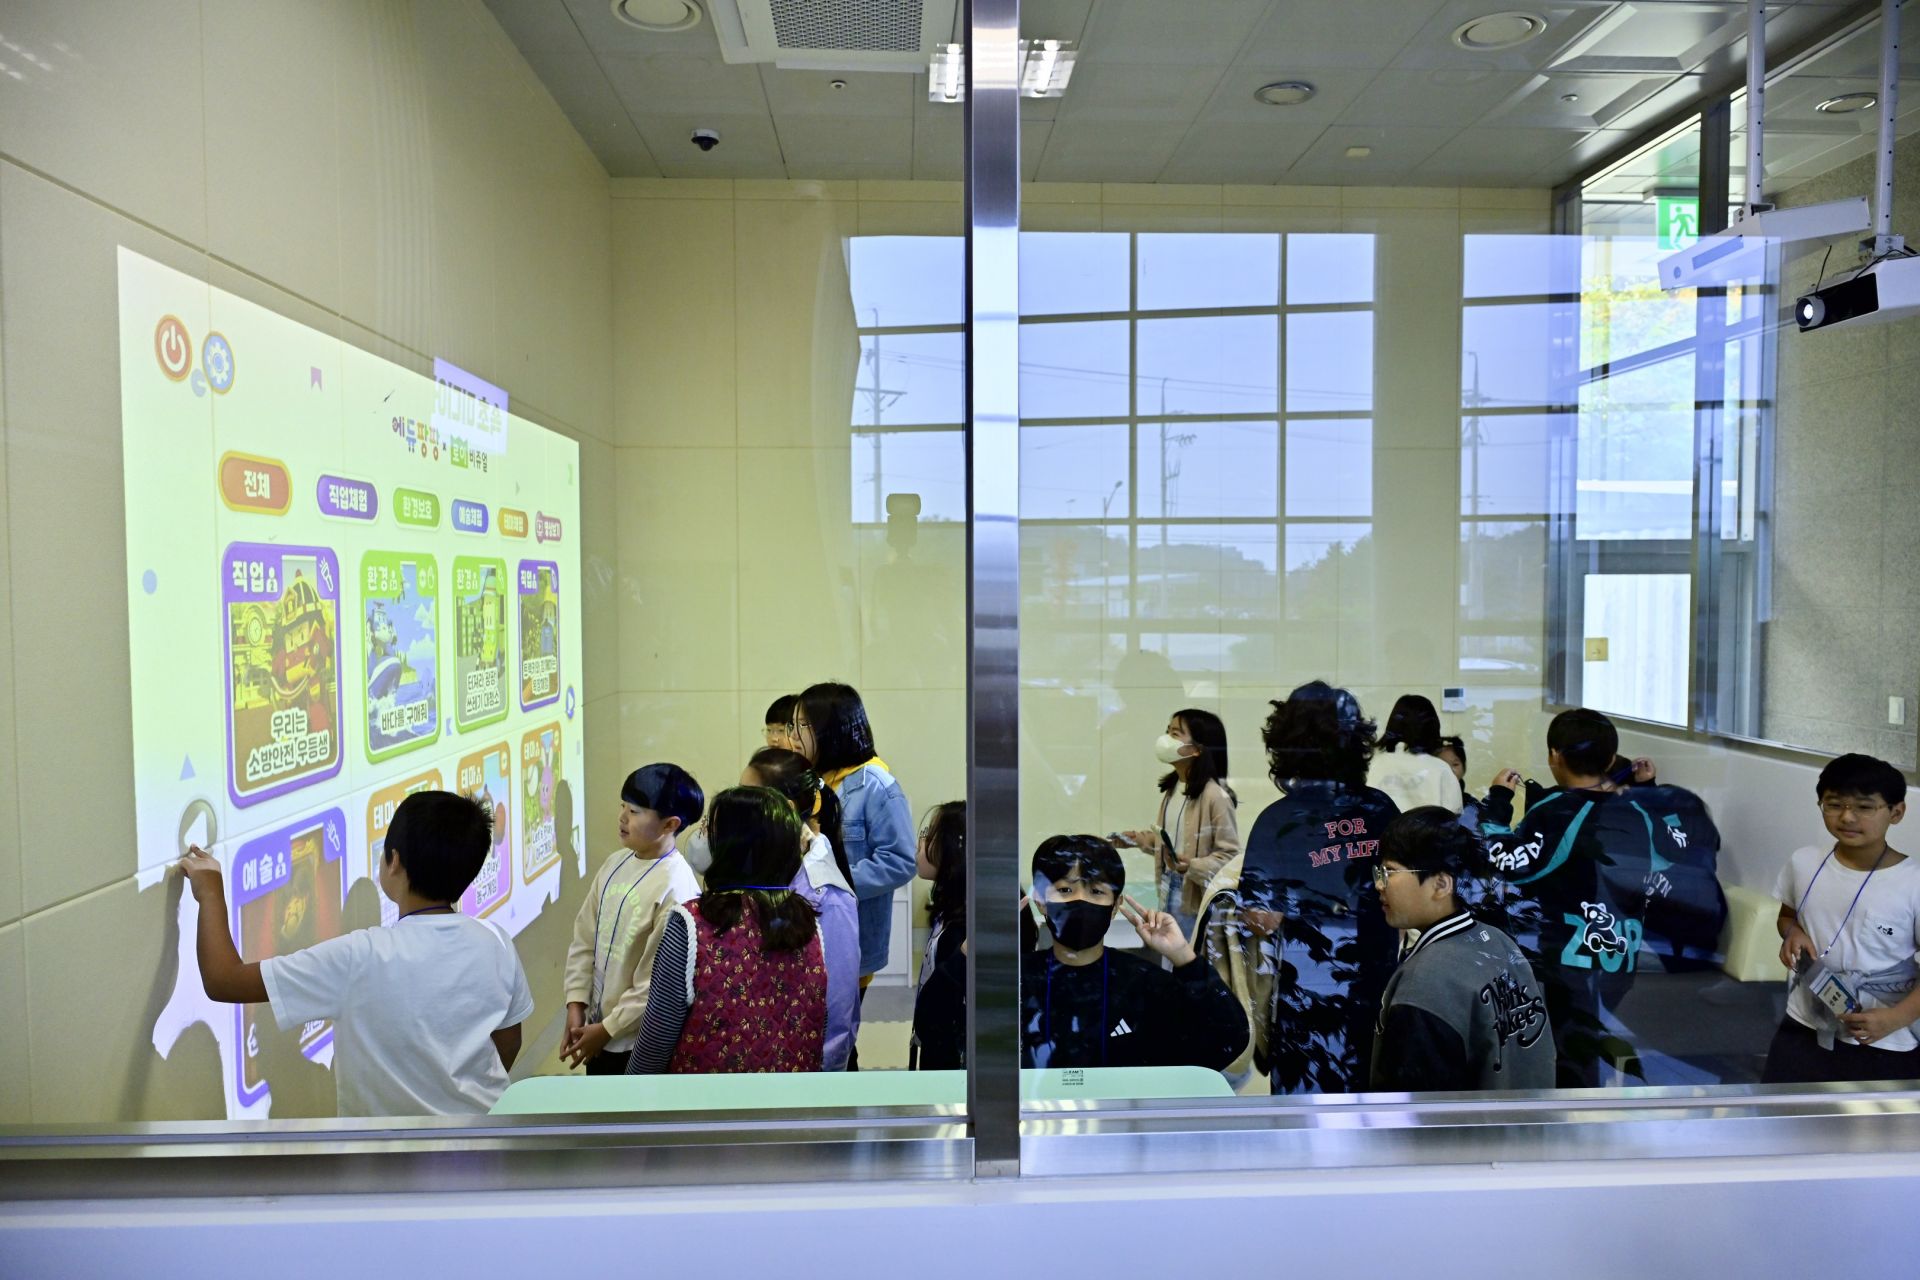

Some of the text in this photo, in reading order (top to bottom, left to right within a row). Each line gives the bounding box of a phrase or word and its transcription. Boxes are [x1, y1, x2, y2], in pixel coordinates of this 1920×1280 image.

[391, 416, 440, 461] 에듀팡팡
[243, 469, 271, 500] 전체
[328, 484, 368, 513] 직업체험
[402, 495, 433, 520] 환경보호
[232, 559, 264, 593] 직업
[367, 565, 389, 591] 환경
[381, 703, 428, 731] 바다를 구해줘
[466, 694, 483, 713] 쓰레기
[272, 711, 306, 738] 우리는
[248, 733, 329, 777] 소방안전 우등생
[461, 766, 476, 790] 테마
[1324, 817, 1367, 839] FOR
[1308, 840, 1380, 868] MY LIF
[242, 853, 273, 891] 예술
